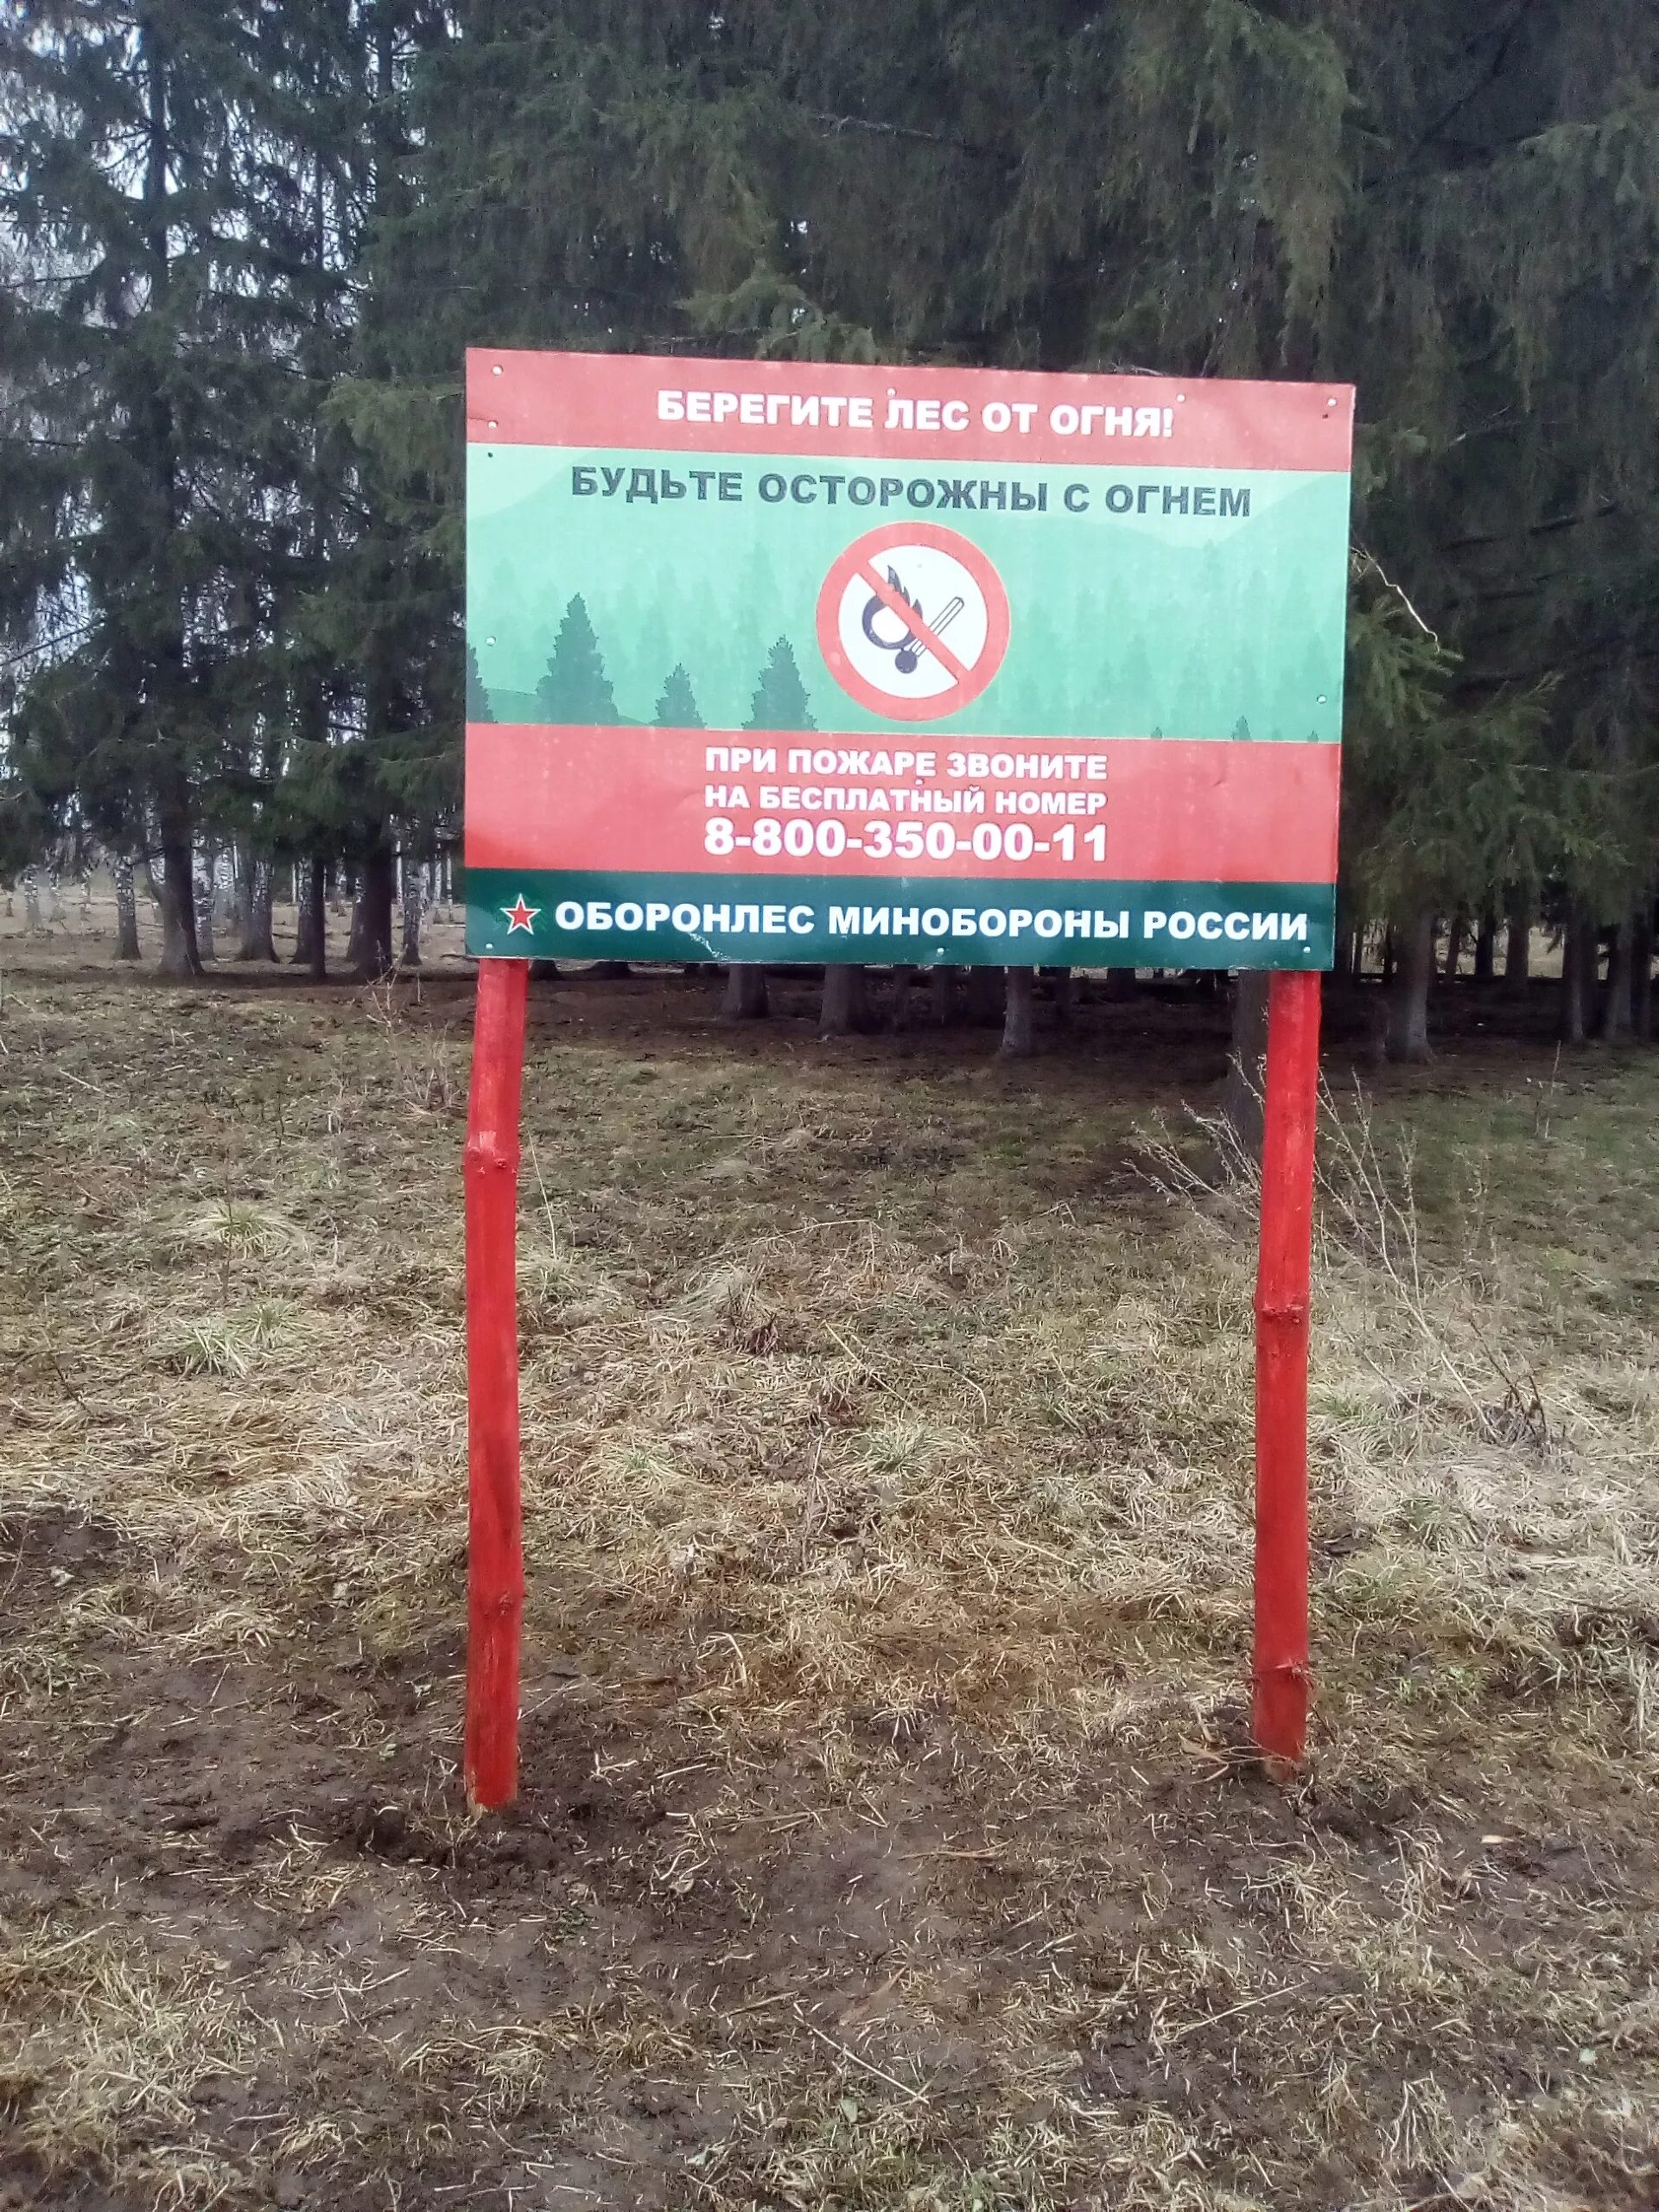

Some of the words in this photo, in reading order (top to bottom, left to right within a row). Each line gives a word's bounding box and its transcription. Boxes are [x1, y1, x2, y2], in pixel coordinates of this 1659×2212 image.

[658, 390, 874, 429] БЕРЕГИТЕ
[884, 397, 969, 431] ЛЕС
[981, 402, 1039, 434] ОТ
[1050, 404, 1174, 437] ОГНЯ!
[572, 466, 743, 504] БУДЬТЕ
[758, 474, 1047, 512] ОСТОРОЖНЫ
[1064, 483, 1090, 513] С
[1105, 485, 1251, 517] ОГНЕМ
[704, 747, 777, 773] ПРИ
[788, 748, 937, 777] ПОЖАРЕ
[946, 753, 1109, 780] ЗВОНИТЕ
[704, 785, 750, 809] НА
[760, 785, 985, 813] БЕСПЛАТНЫЙ
[995, 791, 1109, 815] НОМЕР
[703, 817, 1108, 862] 8-800-350-00-11
[555, 901, 815, 934] ОБОРОНЛЕС
[828, 906, 1130, 938] МИНОБОРОНЫ
[1143, 911, 1308, 941] РОССИИ
